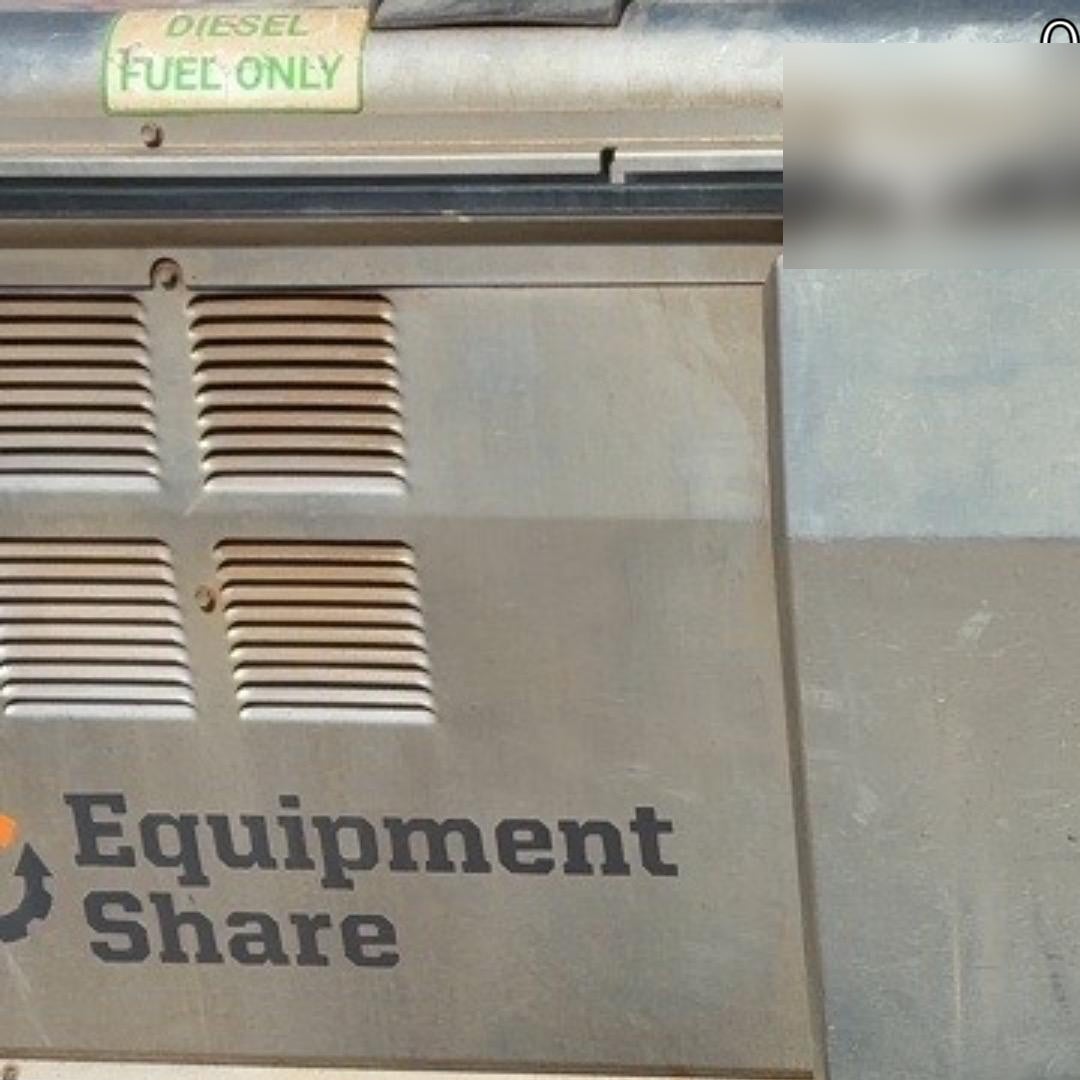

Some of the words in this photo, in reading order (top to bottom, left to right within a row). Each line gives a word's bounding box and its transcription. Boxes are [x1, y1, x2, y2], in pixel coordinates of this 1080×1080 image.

[166, 14, 310, 38] DIESEL
[118, 54, 222, 91] FUEL
[236, 54, 344, 91] ONLY
[64, 793, 680, 891] Equipment
[83, 890, 400, 968] Share
